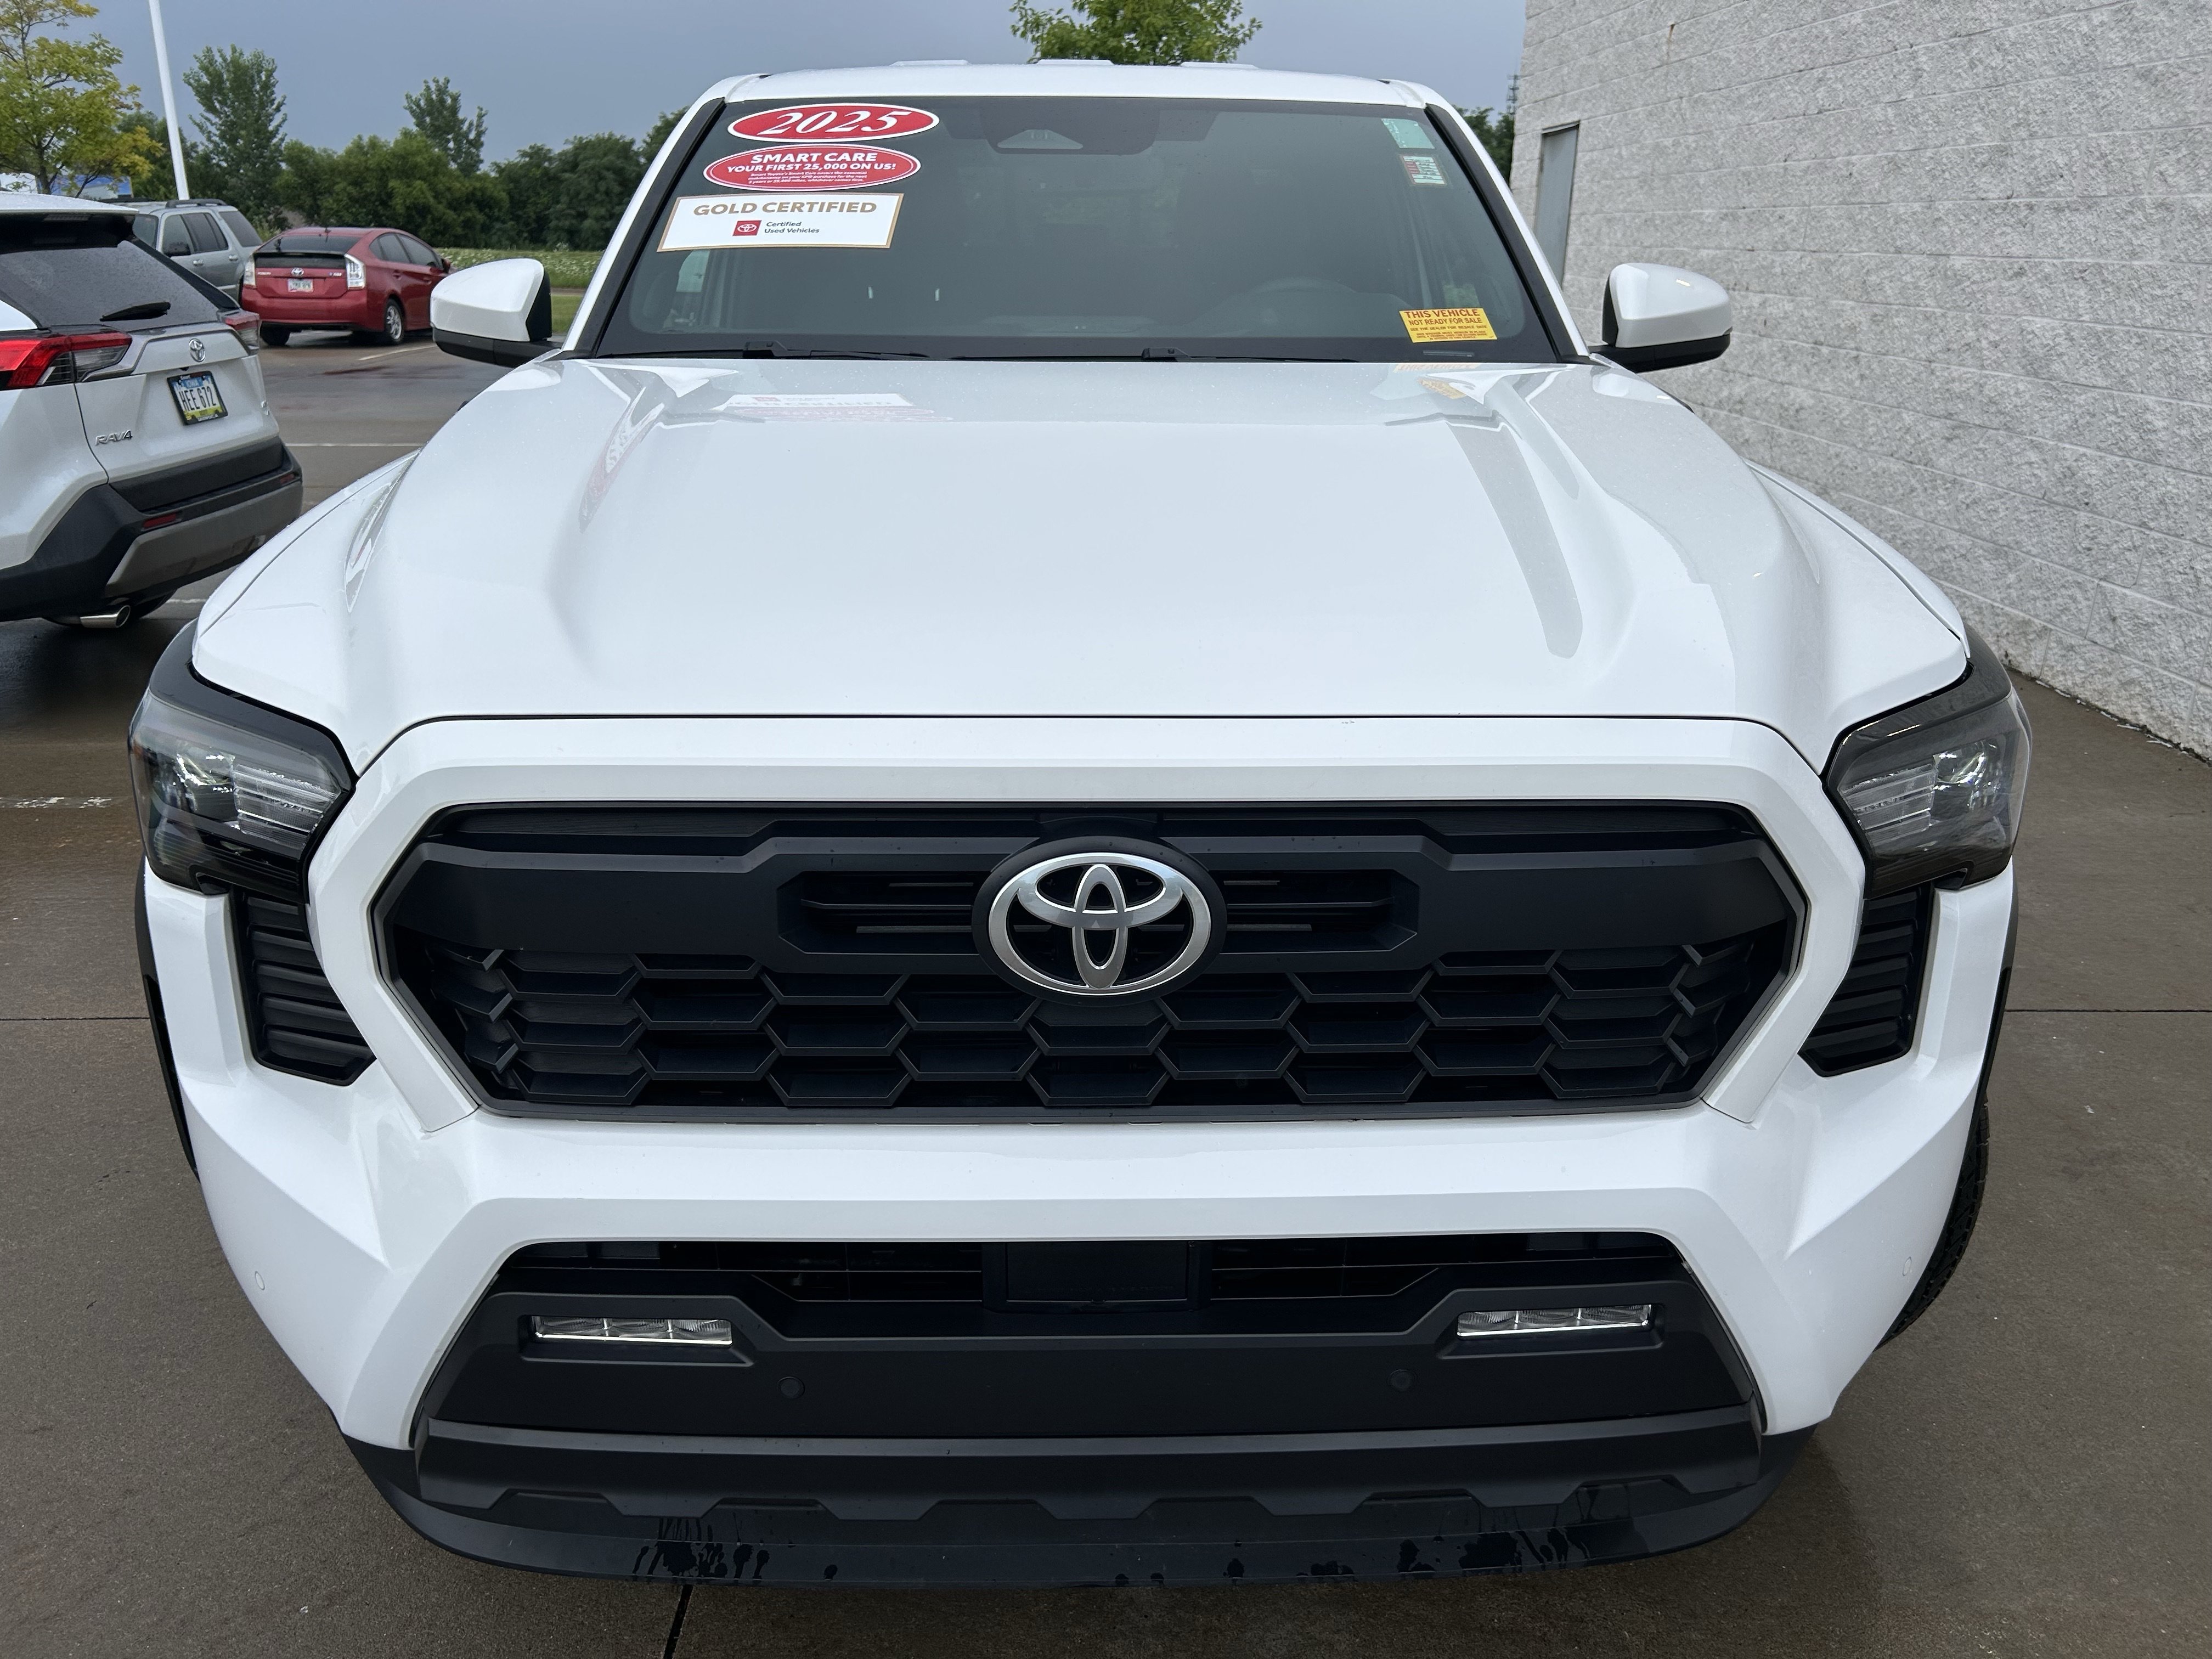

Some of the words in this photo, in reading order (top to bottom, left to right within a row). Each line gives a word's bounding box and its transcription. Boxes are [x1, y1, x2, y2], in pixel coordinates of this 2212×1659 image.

[757, 110, 912, 136] 2025
[750, 153, 823, 164] SMART
[824, 153, 878, 162] CARE
[693, 202, 758, 216] GOLD
[762, 201, 877, 213] CERTIFIED
[1404, 310, 1431, 319] THIS
[1432, 309, 1480, 318] VEHICLE
[178, 389, 200, 412] HEE
[197, 386, 217, 408] 672
[95, 430, 133, 445] RAV4
